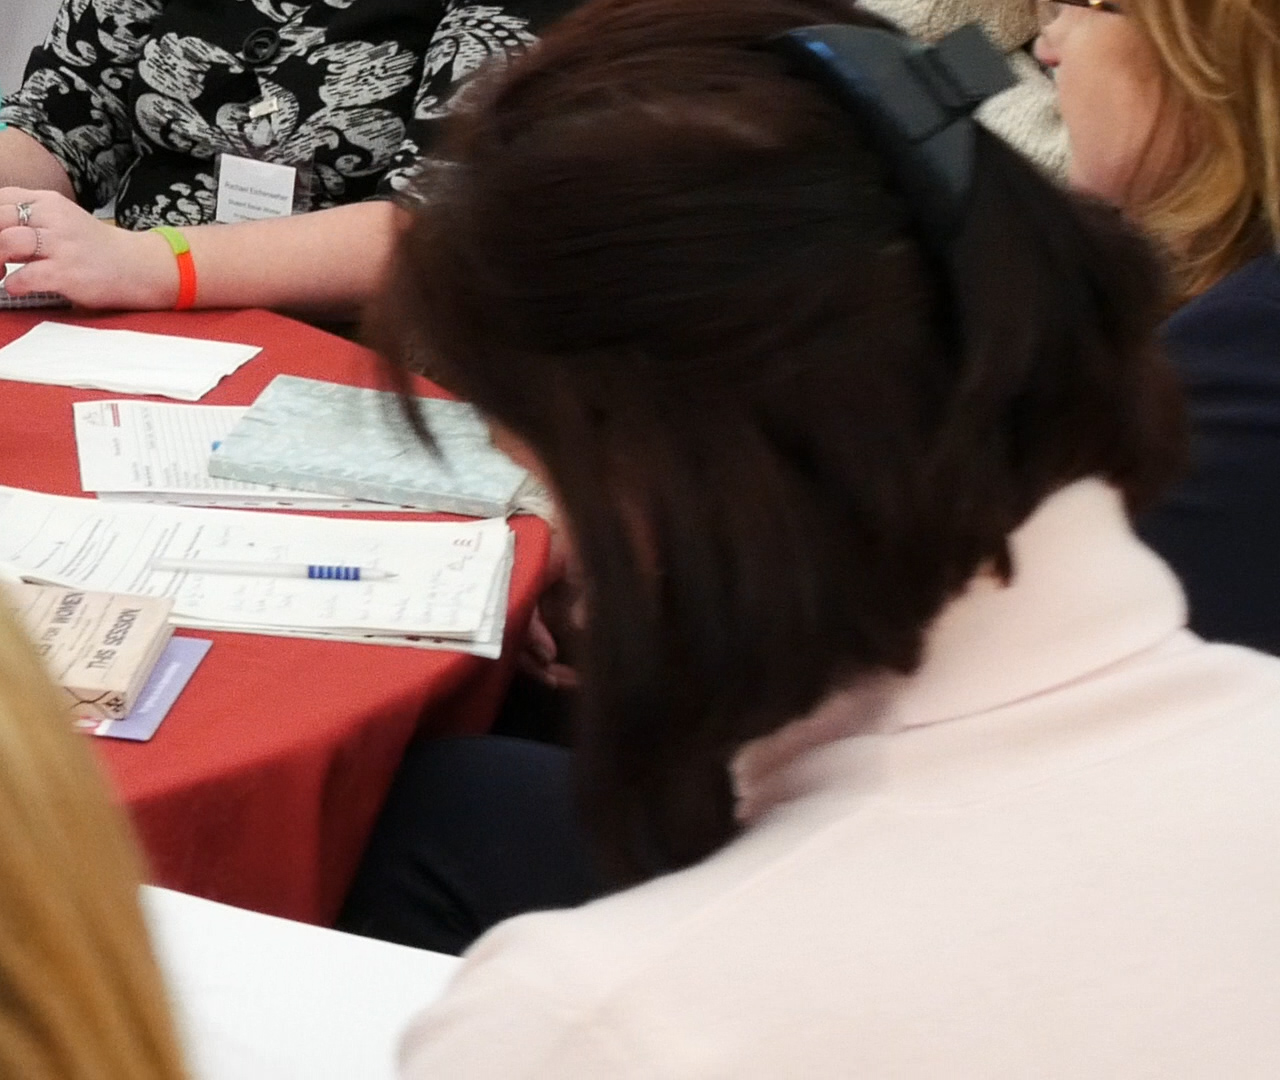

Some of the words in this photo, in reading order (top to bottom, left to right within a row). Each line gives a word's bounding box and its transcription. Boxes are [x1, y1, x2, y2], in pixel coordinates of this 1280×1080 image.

[50, 591, 86, 624] WOMEN
[85, 648, 117, 670] THIS
[103, 607, 142, 647] SESSION
